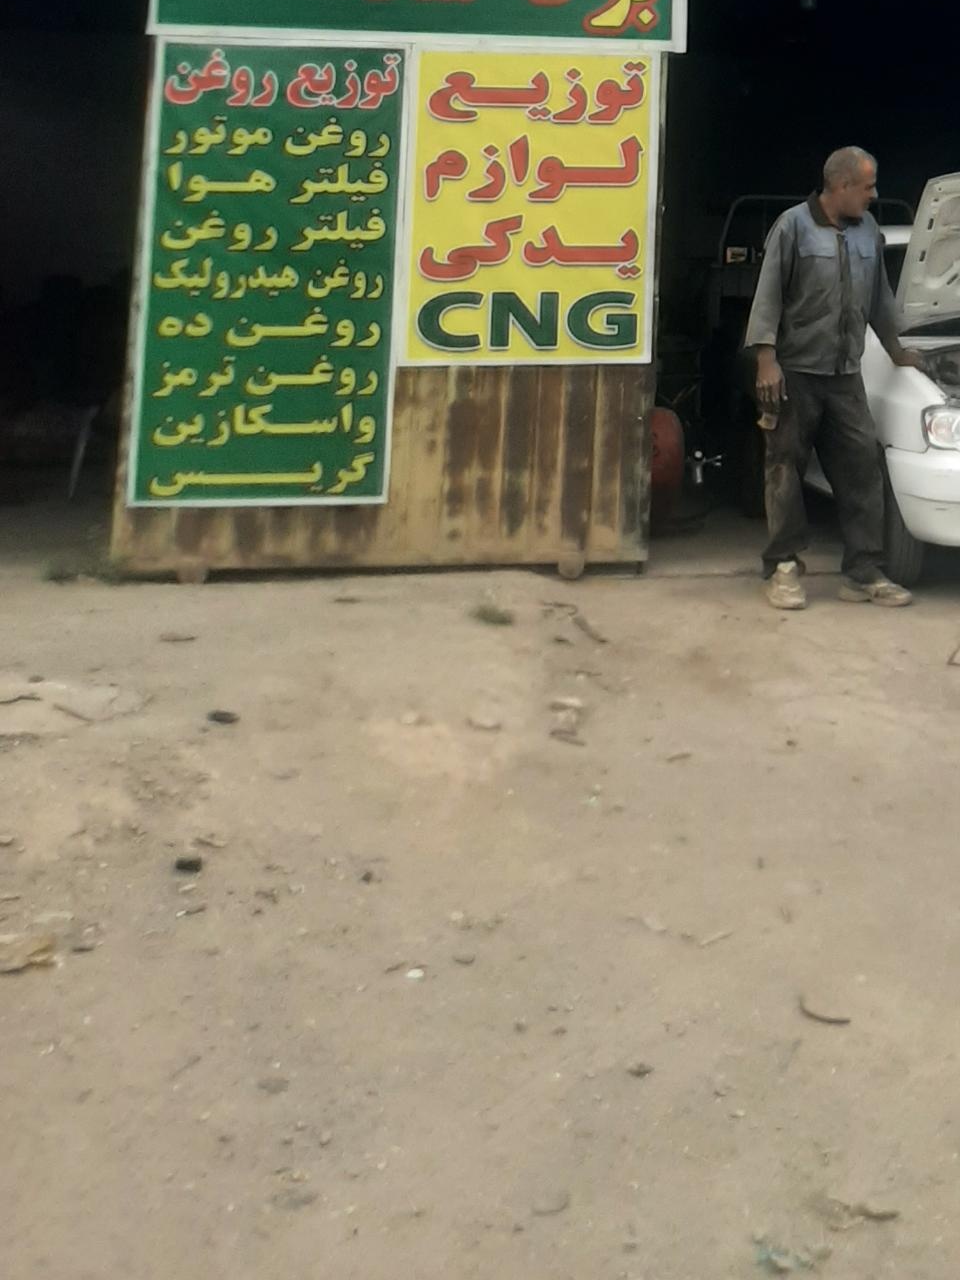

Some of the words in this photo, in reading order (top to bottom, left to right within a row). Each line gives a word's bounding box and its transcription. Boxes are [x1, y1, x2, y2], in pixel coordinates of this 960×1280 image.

[164, 49, 278, 106] روغن
[287, 53, 401, 108] توزیع
[428, 61, 647, 124] توزیع
[164, 115, 273, 154] موتور
[284, 117, 391, 157] روغن
[167, 161, 277, 202] هوا
[290, 162, 389, 203] فیلتر
[424, 134, 643, 202] لوازم
[161, 210, 278, 251] روغن
[291, 209, 387, 251] فیلتر
[419, 214, 642, 281] یدکی
[153, 257, 298, 299] هیدرولیک
[307, 259, 383, 298] روغن
[158, 313, 213, 337] ده
[226, 307, 380, 346] روغن
[417, 291, 638, 351] CNG
[153, 356, 236, 397] ترمز
[246, 355, 378, 395] روغن
[153, 402, 375, 446] واسکازین
[150, 453, 374, 496] گریس
